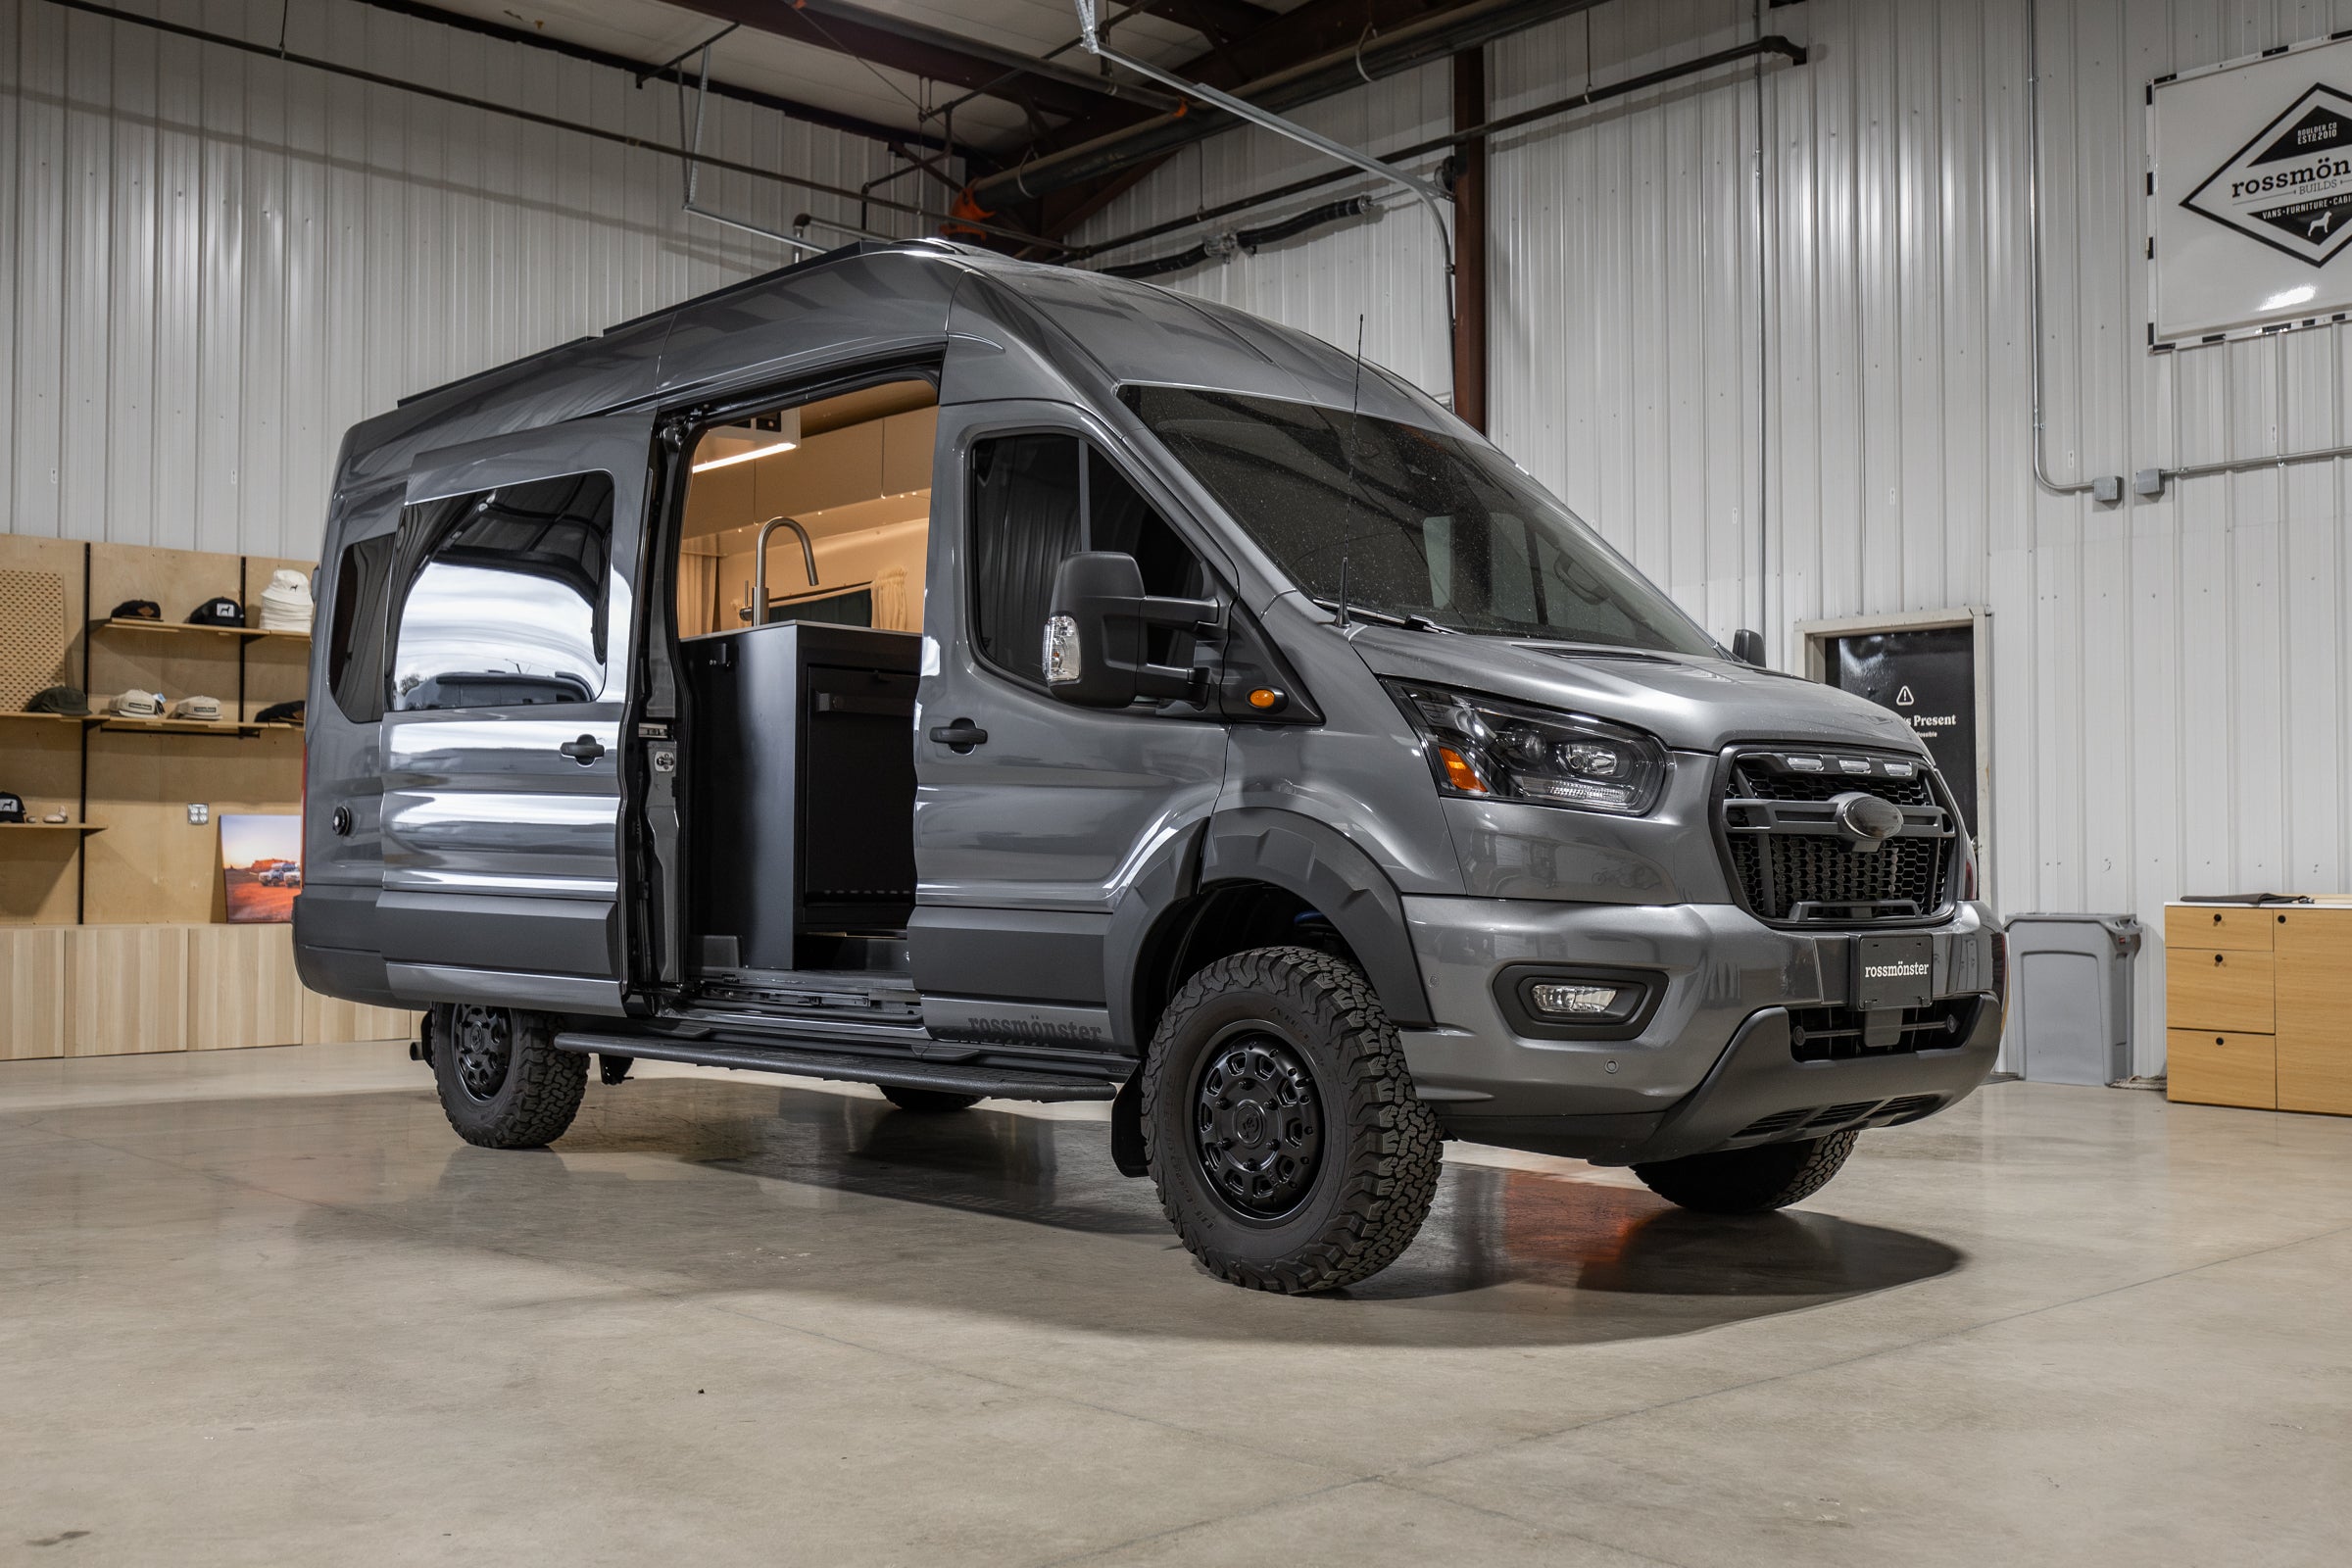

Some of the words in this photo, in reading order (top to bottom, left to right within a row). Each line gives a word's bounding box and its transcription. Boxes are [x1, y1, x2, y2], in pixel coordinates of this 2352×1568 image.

[2318, 128, 2337, 141] 2010
[2231, 157, 2351, 198] rossmön
[2299, 179, 2337, 195] BUILDS
[2262, 209, 2281, 220] VANS
[2286, 199, 2328, 216] FURNITURE
[1913, 714, 1957, 727] Present
[1865, 960, 1930, 978] rossmönster
[967, 1014, 1102, 1042] rossmönster
